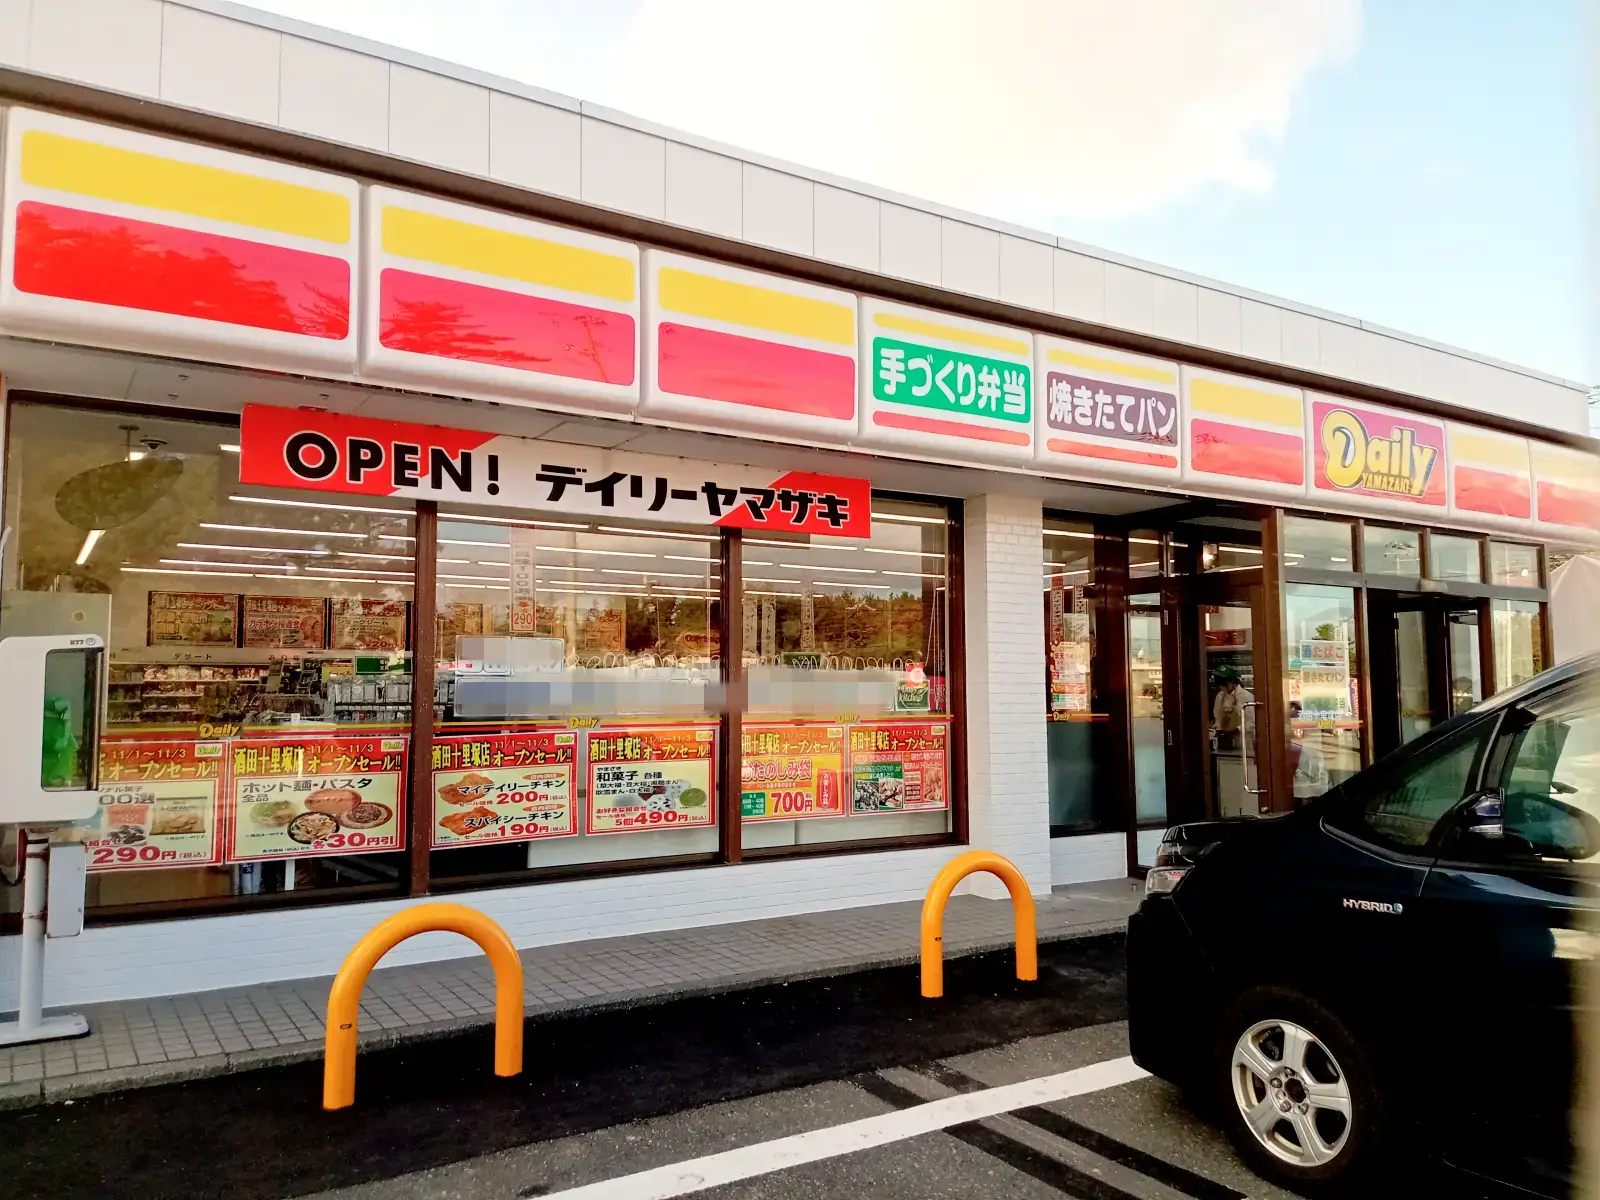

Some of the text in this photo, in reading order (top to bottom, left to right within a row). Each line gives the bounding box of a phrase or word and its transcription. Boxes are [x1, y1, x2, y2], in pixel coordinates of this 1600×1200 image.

[879, 348, 1027, 416] 手づくり弁当
[1049, 378, 1178, 443] 焼きたてパン
[1322, 409, 1438, 497] Daily
[283, 430, 852, 528] OPEN! デイリーヤマザキ
[1362, 472, 1413, 494] YAMAZAKI
[200, 723, 240, 738] Daily
[570, 717, 599, 728] Daily
[596, 771, 638, 782] 和菓子
[242, 794, 269, 803] 全品
[464, 811, 564, 827] スパイシーチキン
[1343, 898, 1396, 914] HYBRID
